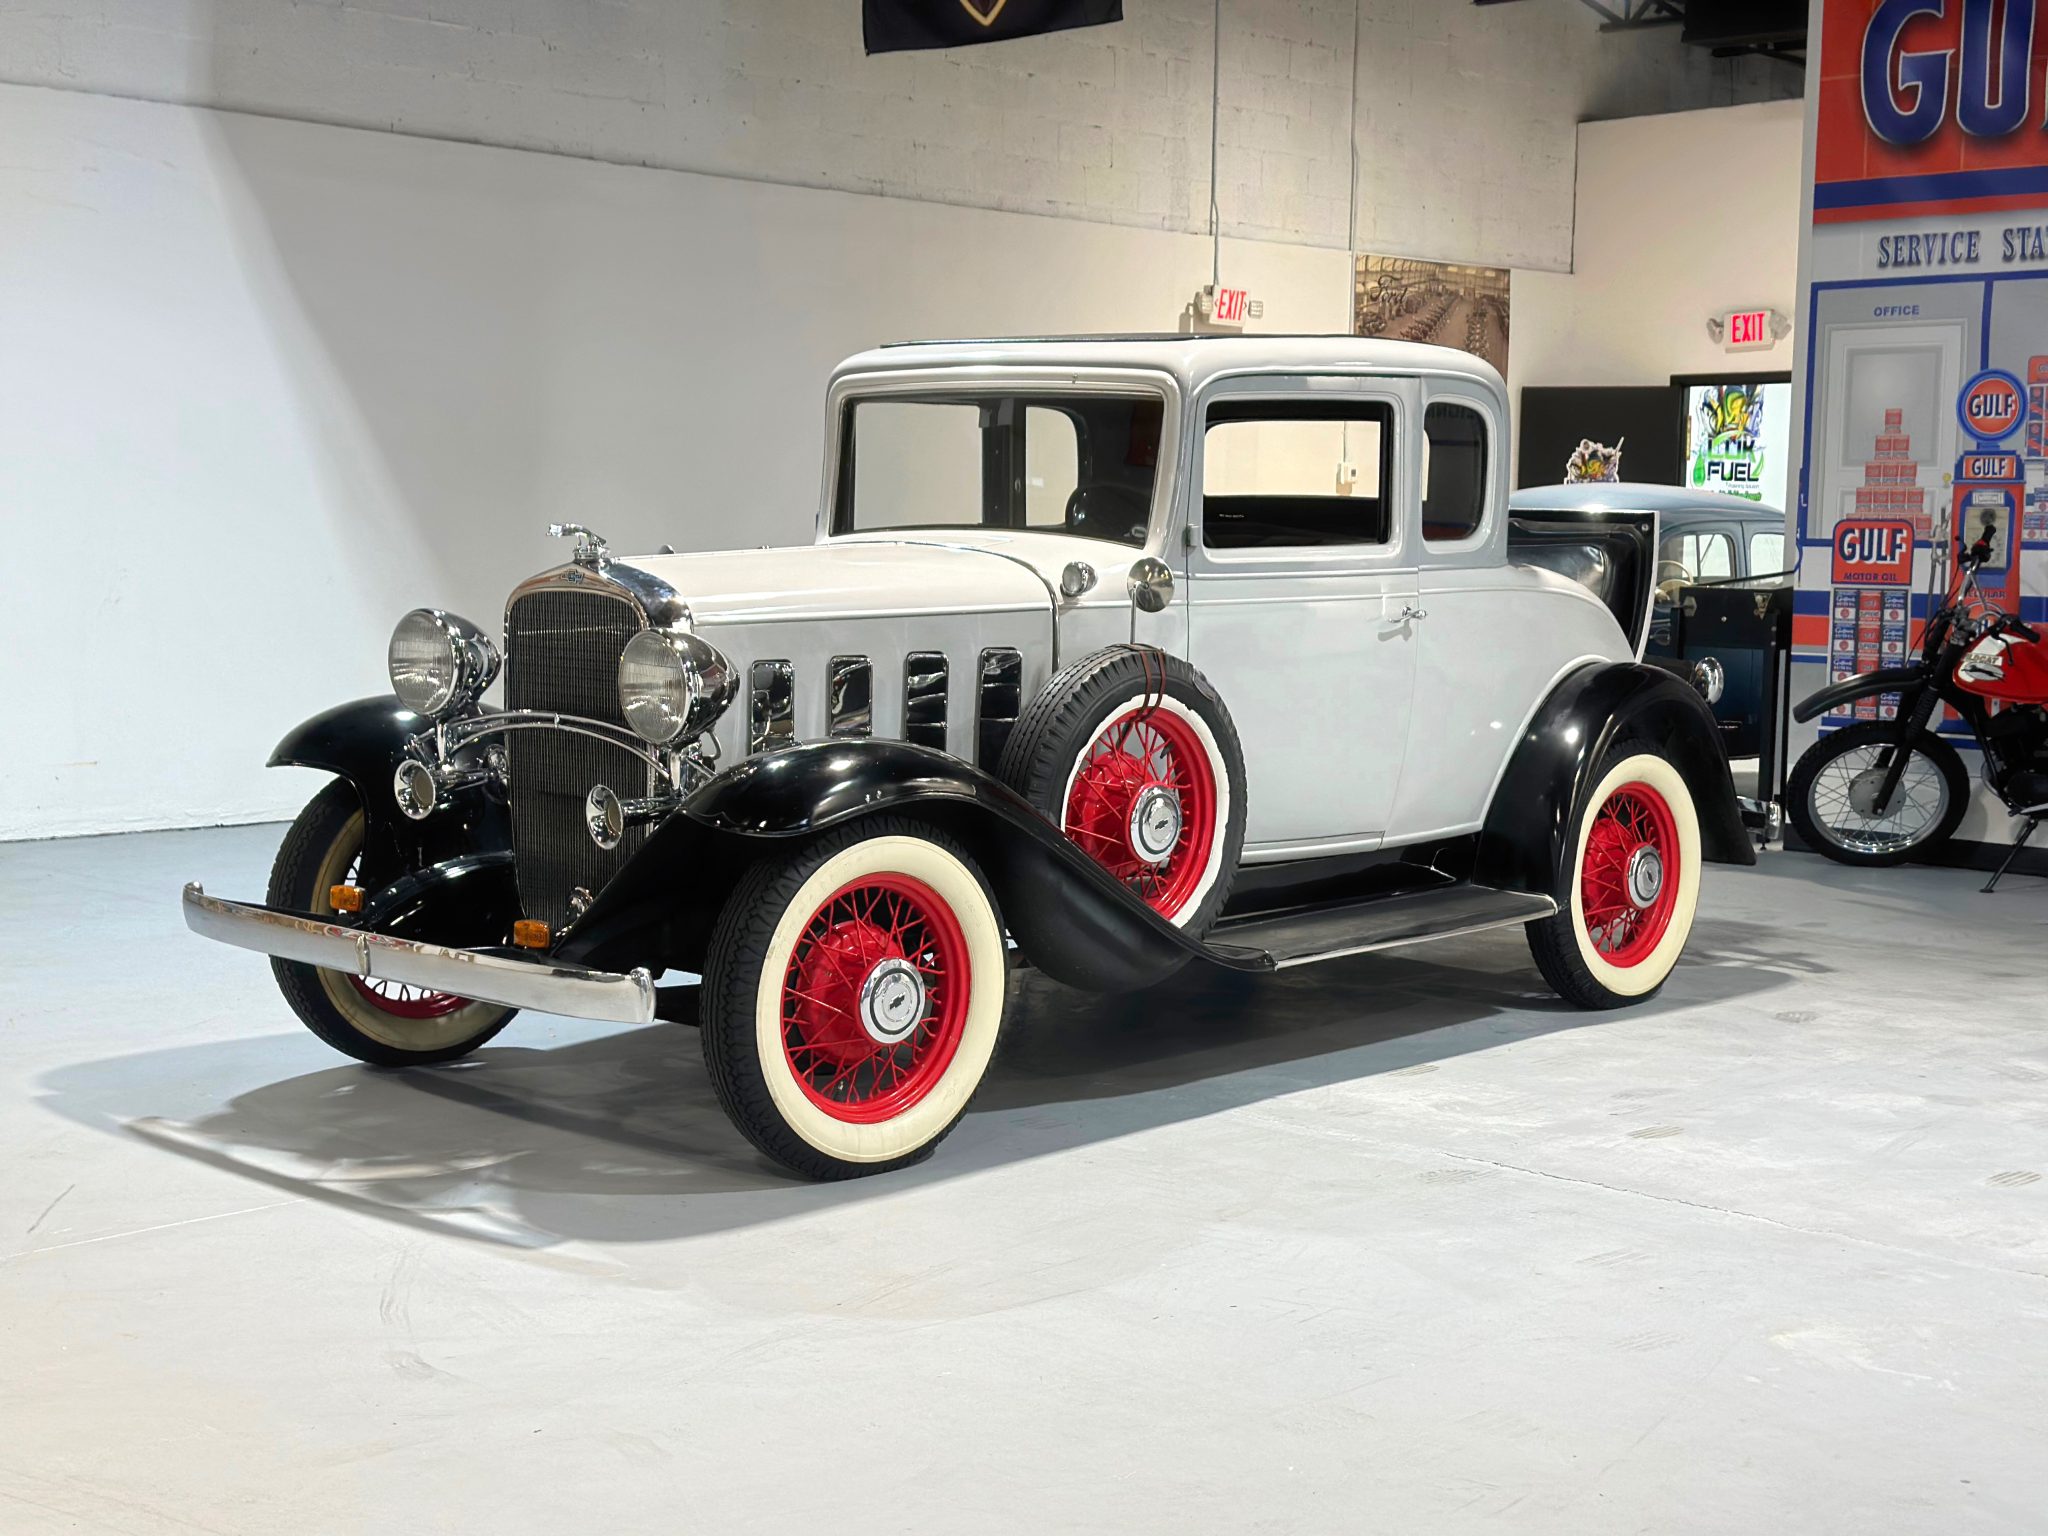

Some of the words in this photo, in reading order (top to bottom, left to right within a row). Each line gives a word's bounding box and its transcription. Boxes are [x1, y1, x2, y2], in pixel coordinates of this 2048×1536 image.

[1861, 0, 2048, 144] GU
[1877, 231, 1980, 268] SERVICE
[2002, 226, 2048, 262] STA
[1217, 288, 1247, 321] EXIT
[1873, 305, 1920, 317] OFFICE
[1731, 311, 1765, 343] EXIT
[1968, 393, 2016, 418] GULF
[1707, 461, 1759, 482] FUEL
[1971, 457, 2007, 477] GULF
[1838, 528, 1908, 565] GULF
[1843, 572, 1878, 581] MOTOR
[1881, 573, 1897, 582] OIL
